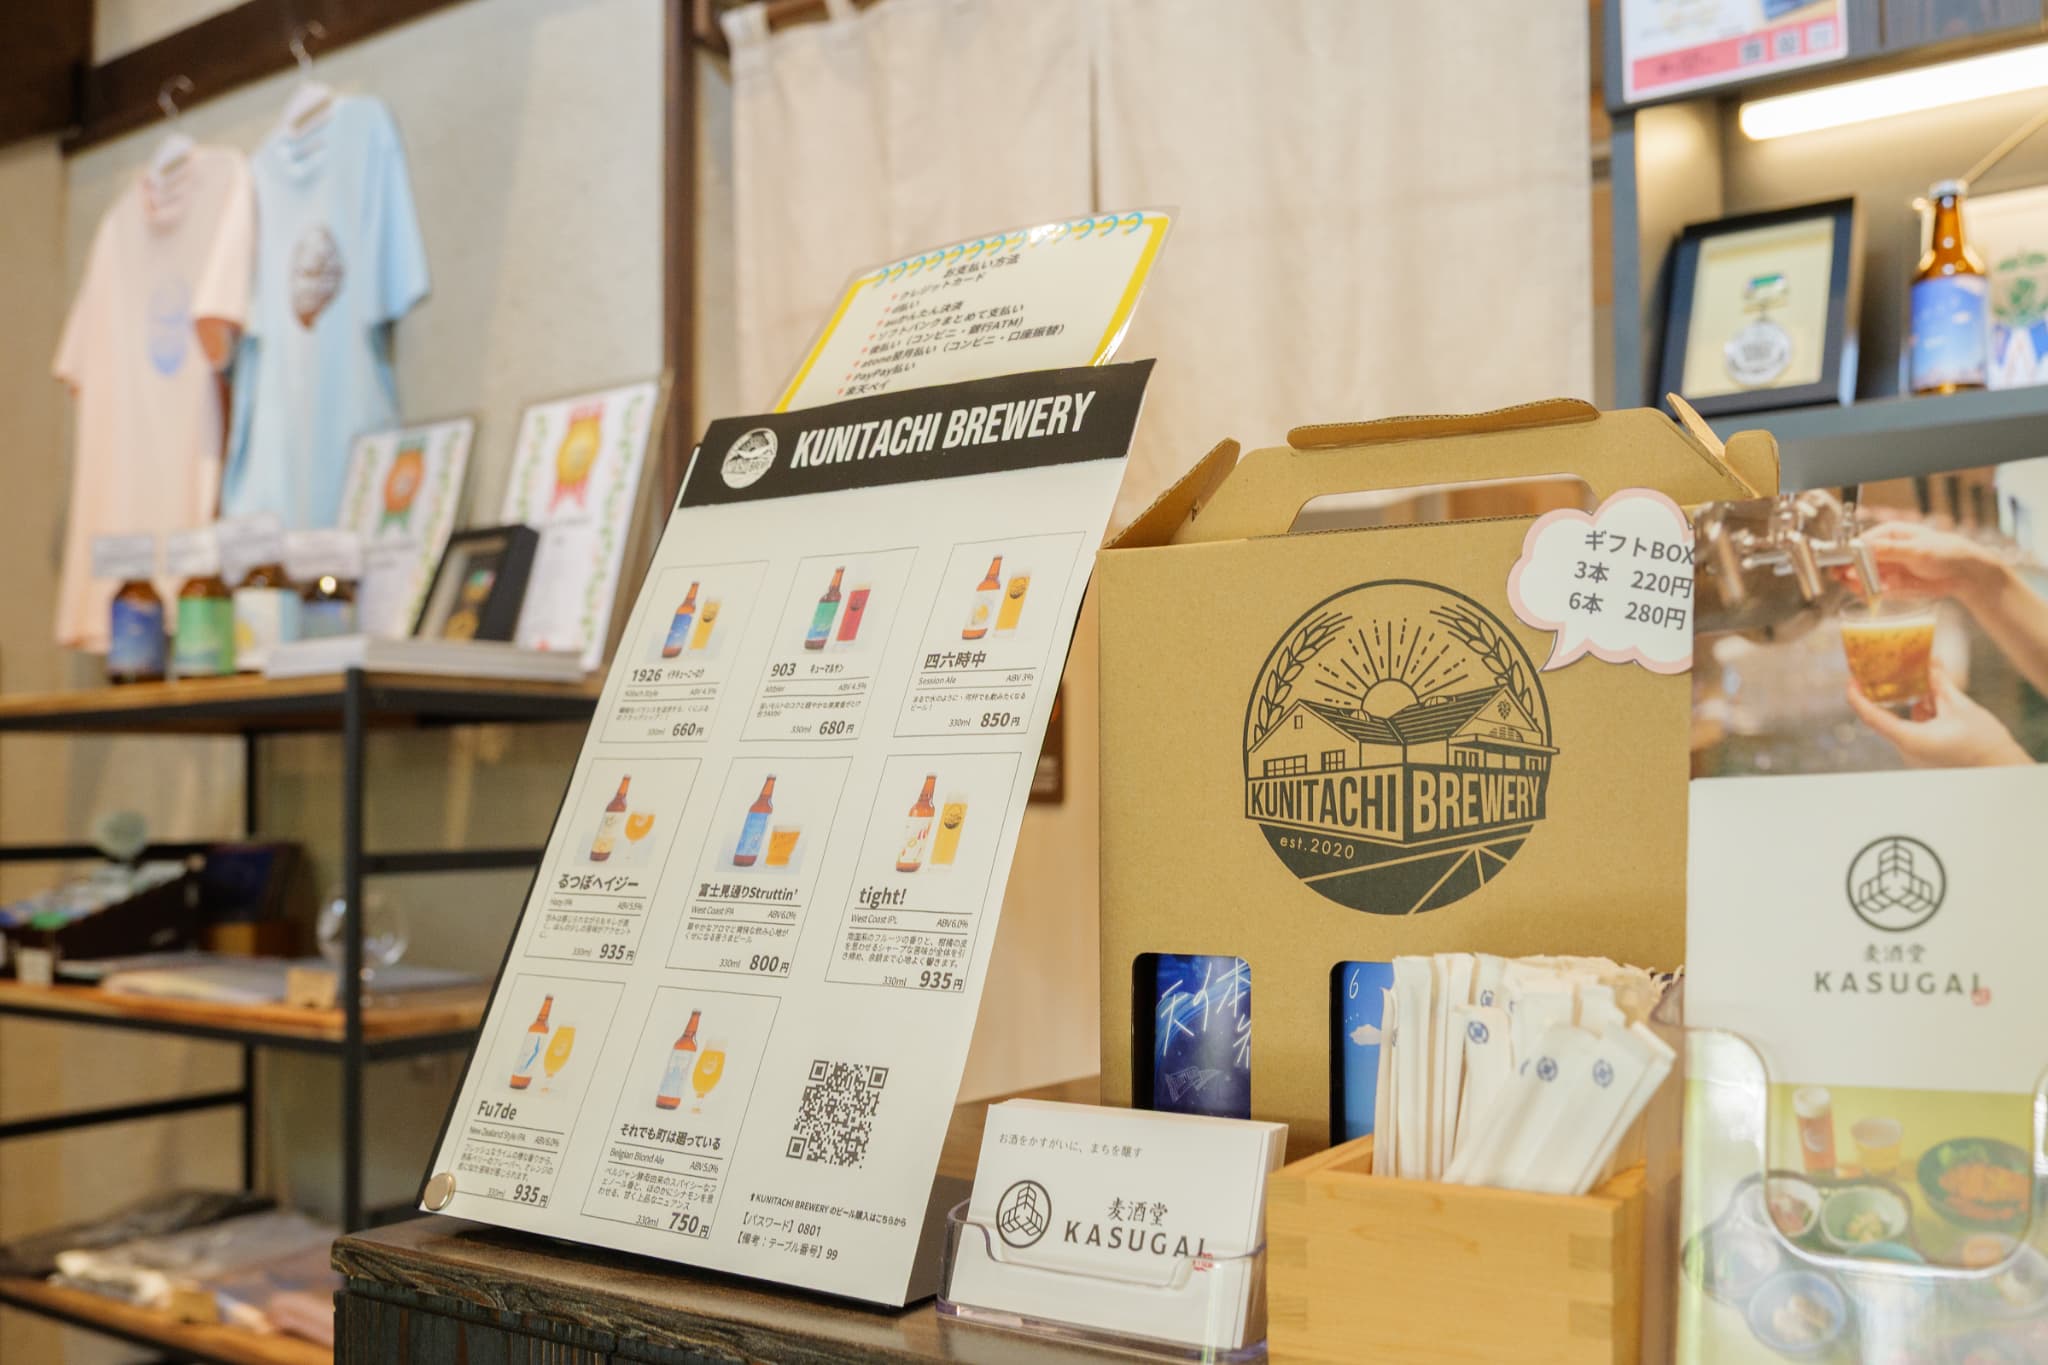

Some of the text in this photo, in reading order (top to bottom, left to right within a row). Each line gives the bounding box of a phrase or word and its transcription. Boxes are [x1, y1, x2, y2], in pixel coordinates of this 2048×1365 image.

[790, 391, 1096, 469] KUNITACHI BREWERY
[1585, 530, 1695, 566] ギフトBOX
[1574, 561, 1694, 599] 3本 220円
[1569, 592, 1686, 631] 6本 280円
[771, 663, 797, 677] 903
[924, 650, 987, 669] 四六時中
[632, 669, 663, 682] 1926
[918, 677, 944, 685] Session
[672, 723, 704, 737] 660円
[949, 712, 1020, 728] 330ml 850円
[1251, 770, 1541, 833] KUNITACHI BREWERY
[1280, 836, 1355, 860] est.2020
[559, 874, 639, 891] るつぼヘイジー
[859, 886, 907, 909] tight!
[851, 912, 867, 923] West
[867, 913, 887, 924] Coast
[719, 958, 741, 968] 330ml
[883, 970, 963, 991] 330ml 935円
[1814, 971, 1980, 995] KASUGAI
[477, 1100, 518, 1120] Fu7de
[620, 1123, 721, 1151] それでも町は廻っている
[756, 1193, 794, 1209] KUNITACHI
[1107, 1197, 1168, 1227] 麦酒堂
[635, 1212, 709, 1238] 330ml 750円
[1064, 1221, 1205, 1257] KASUGAI
